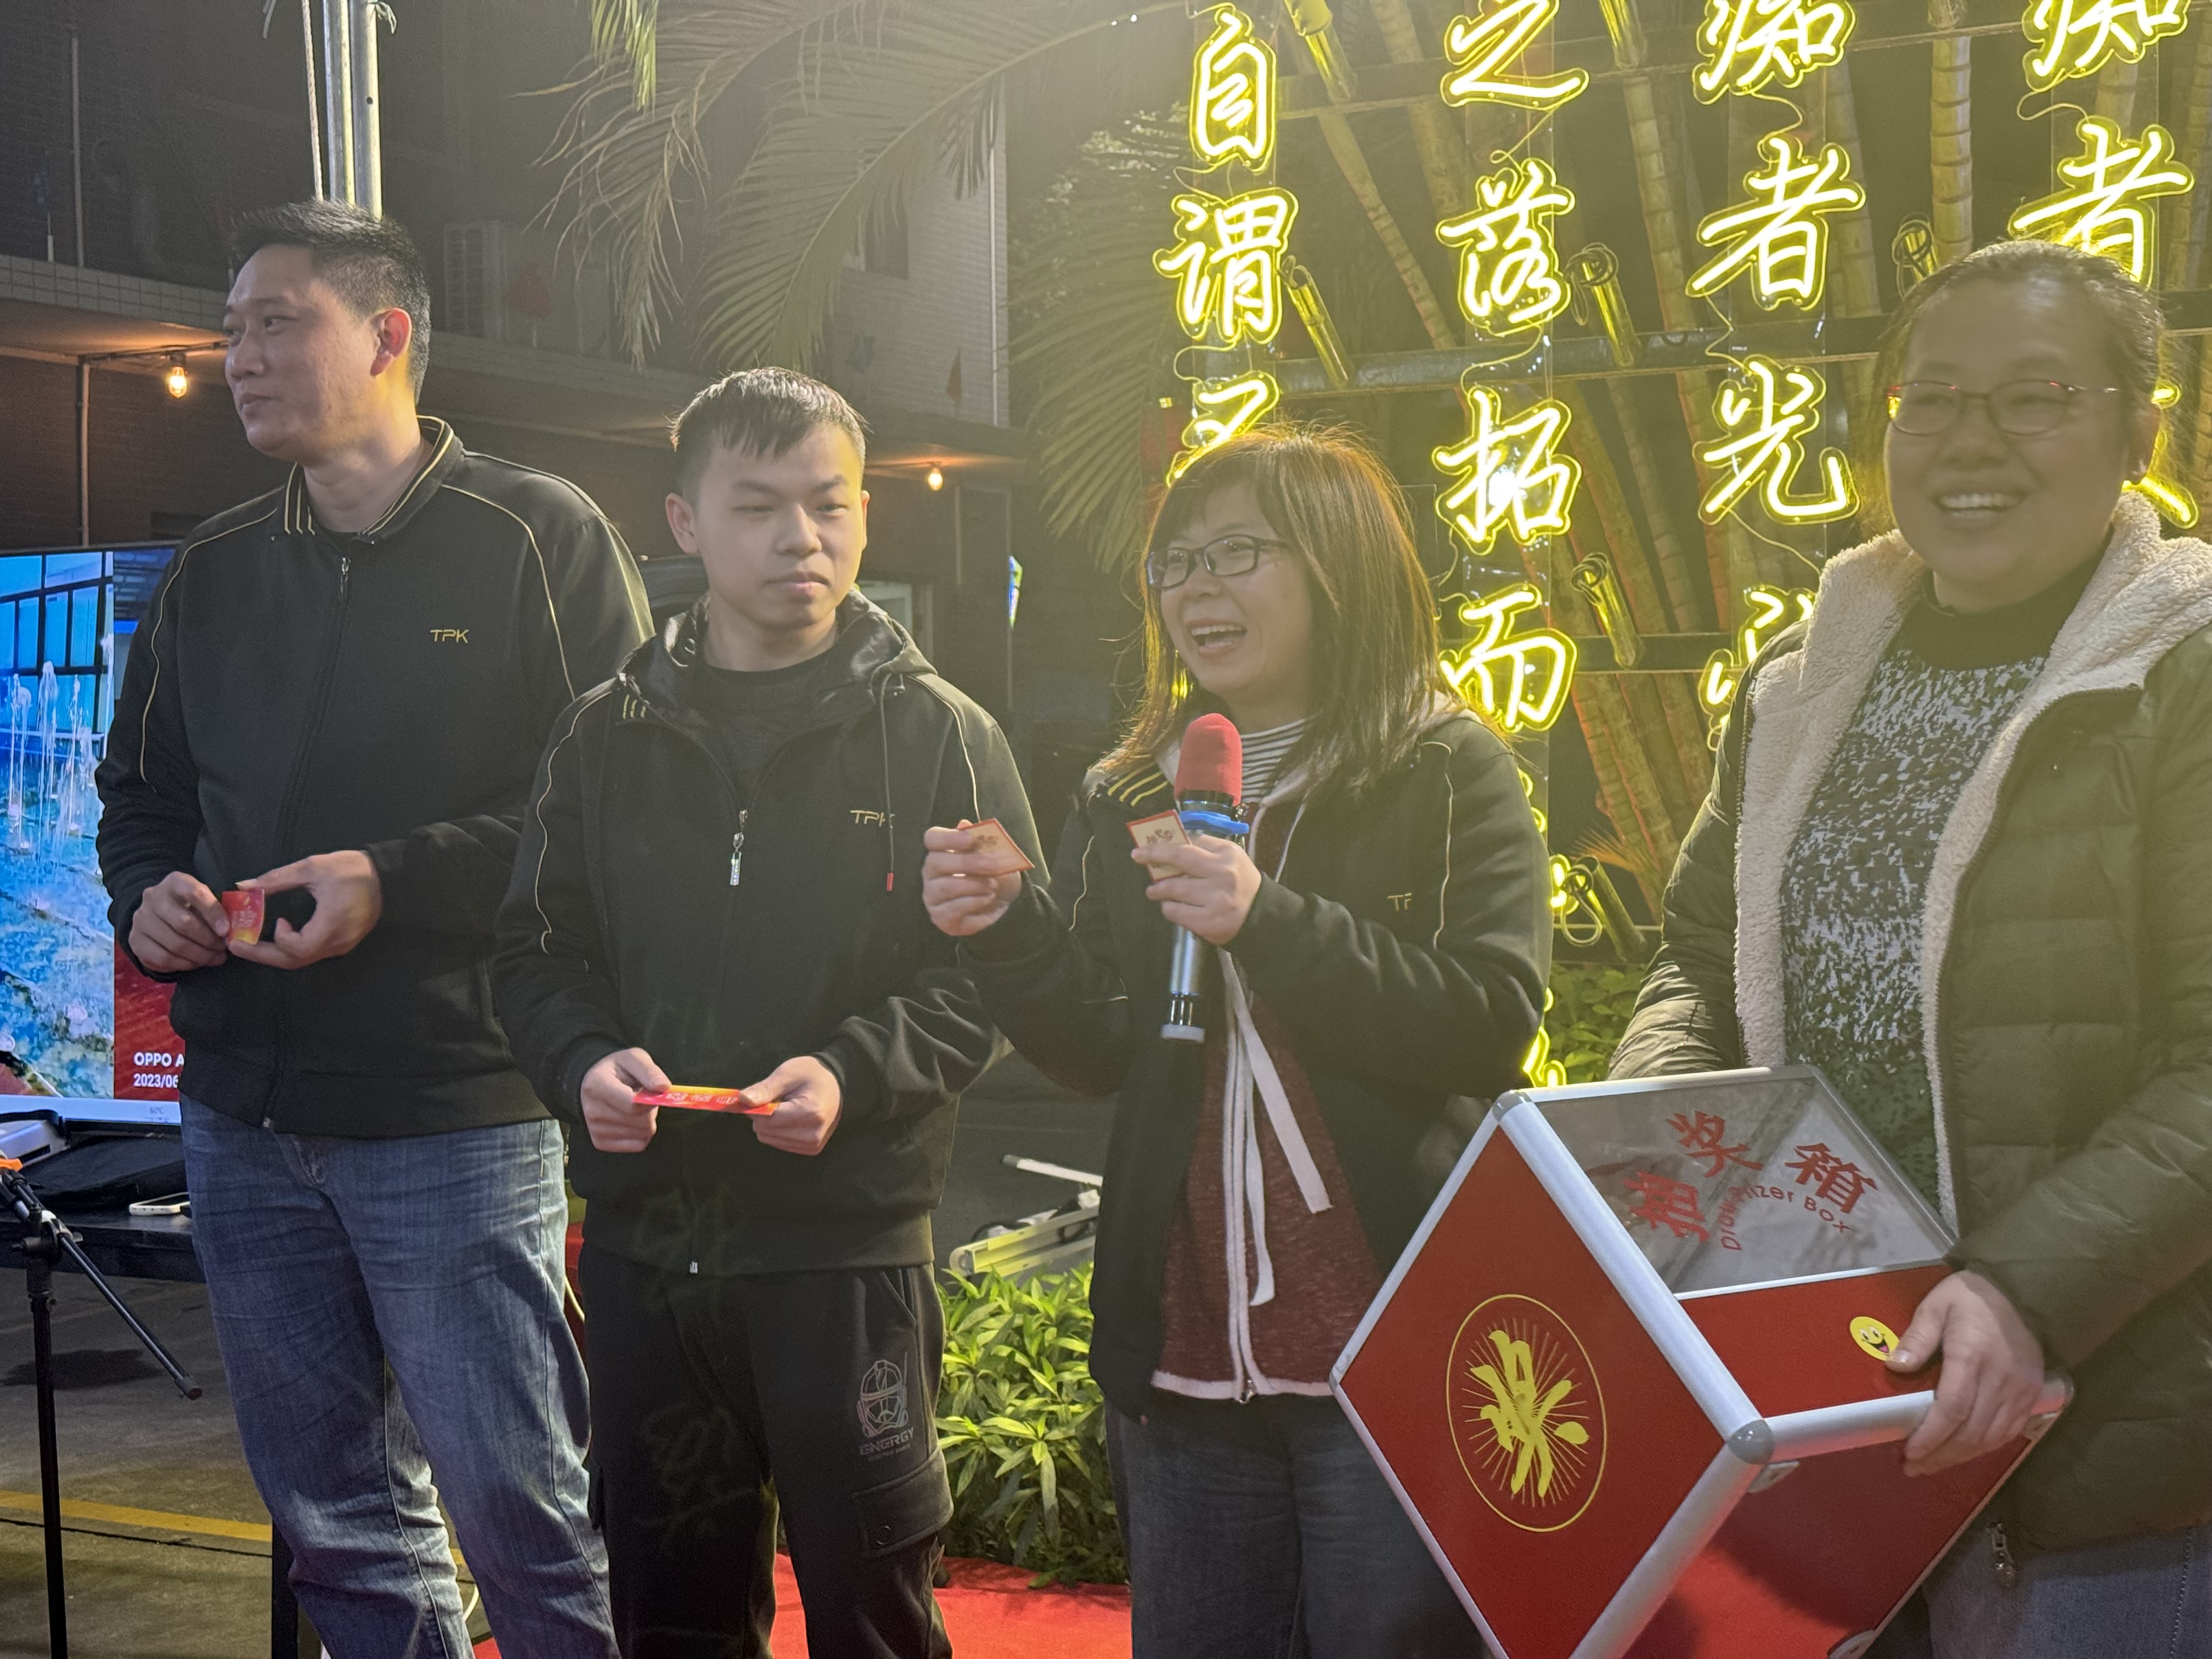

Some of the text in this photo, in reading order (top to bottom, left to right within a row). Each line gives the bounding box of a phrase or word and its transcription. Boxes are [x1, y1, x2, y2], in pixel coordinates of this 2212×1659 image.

[430, 629, 470, 644] TPK
[134, 1052, 172, 1067] OPPO
[1623, 1110, 1878, 1244] 抽奖箱
[1804, 1195, 1850, 1233] Box
[859, 1426, 914, 1456] ENERGY
